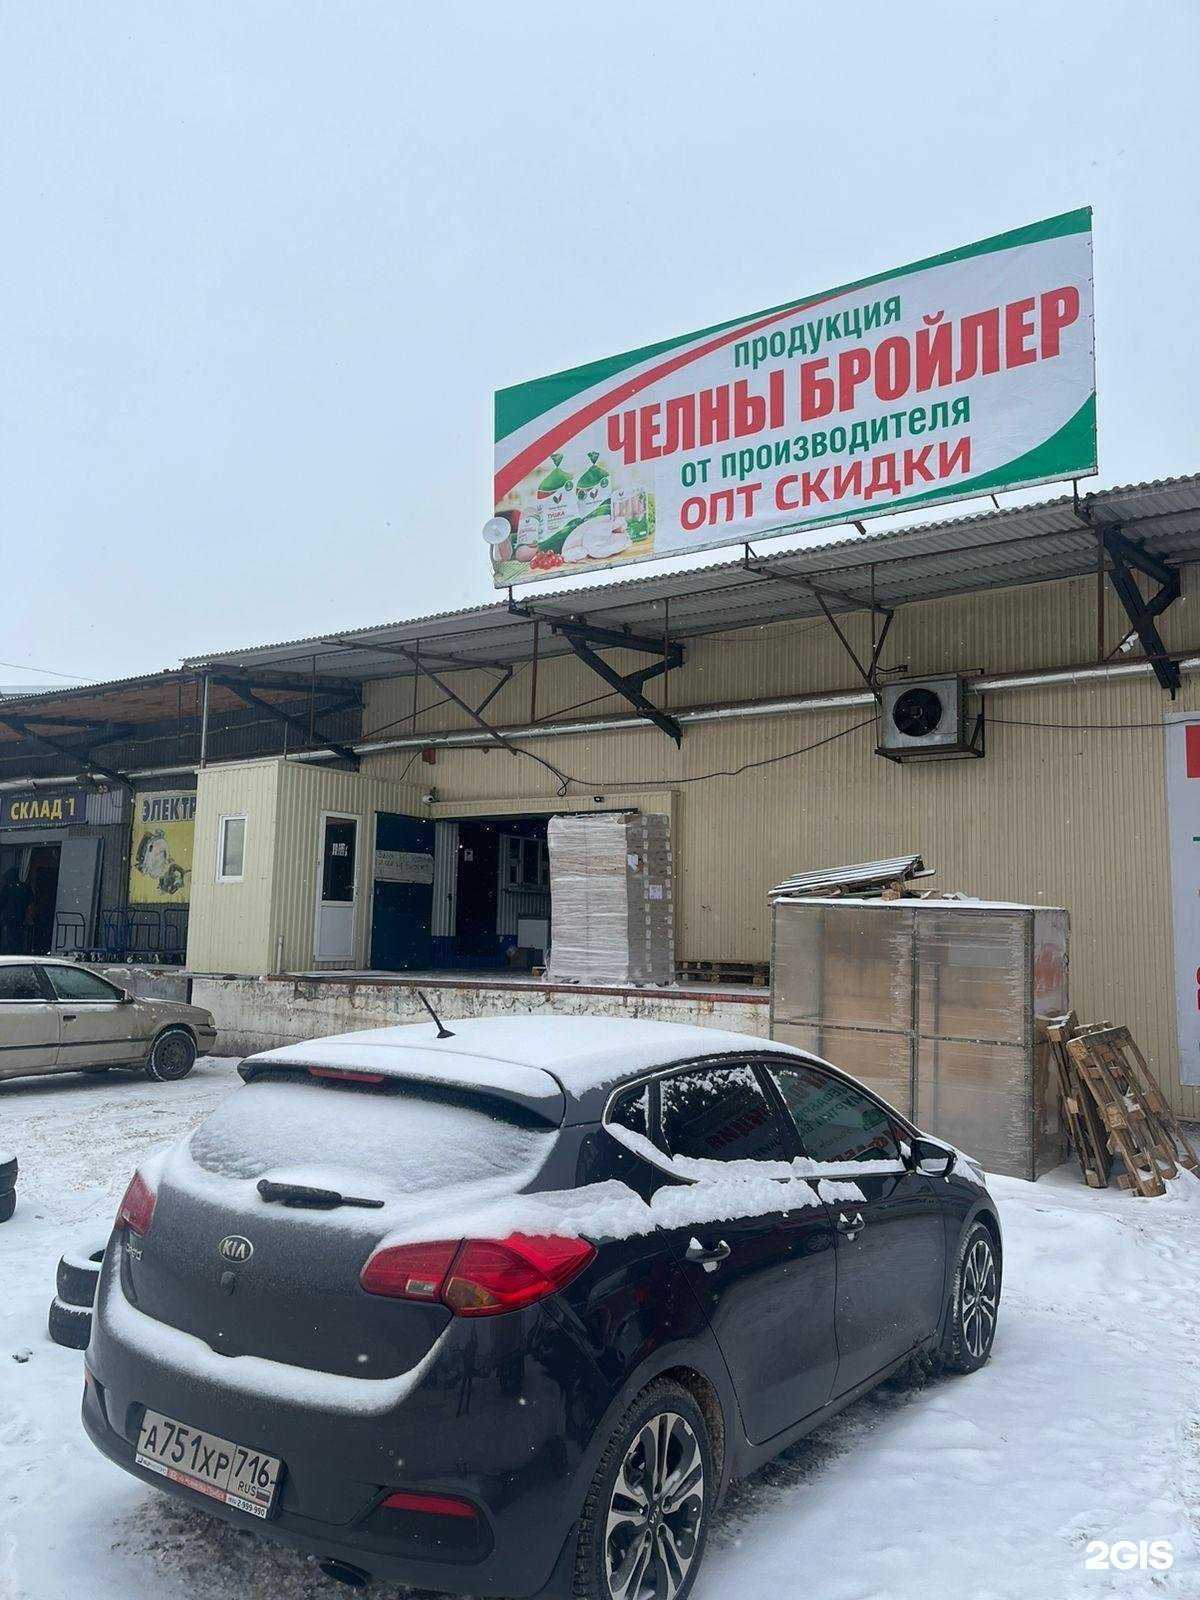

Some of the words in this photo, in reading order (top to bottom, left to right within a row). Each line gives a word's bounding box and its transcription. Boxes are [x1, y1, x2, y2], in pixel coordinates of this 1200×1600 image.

[734, 295, 901, 369] продукция
[607, 369, 784, 465] ЧЕЛНЫ
[800, 285, 1080, 422] БРОЙЛЕР
[681, 458, 711, 487] от
[721, 396, 970, 481] производителя
[680, 482, 762, 531] ОПТ
[775, 436, 971, 511] СКИДКИ
[10, 798, 63, 821] СКЛАД
[68, 797, 76, 816] 1
[222, 1239, 247, 1260] KIA
[234, 1449, 271, 1488] 716
[238, 1480, 257, 1497] RUS
